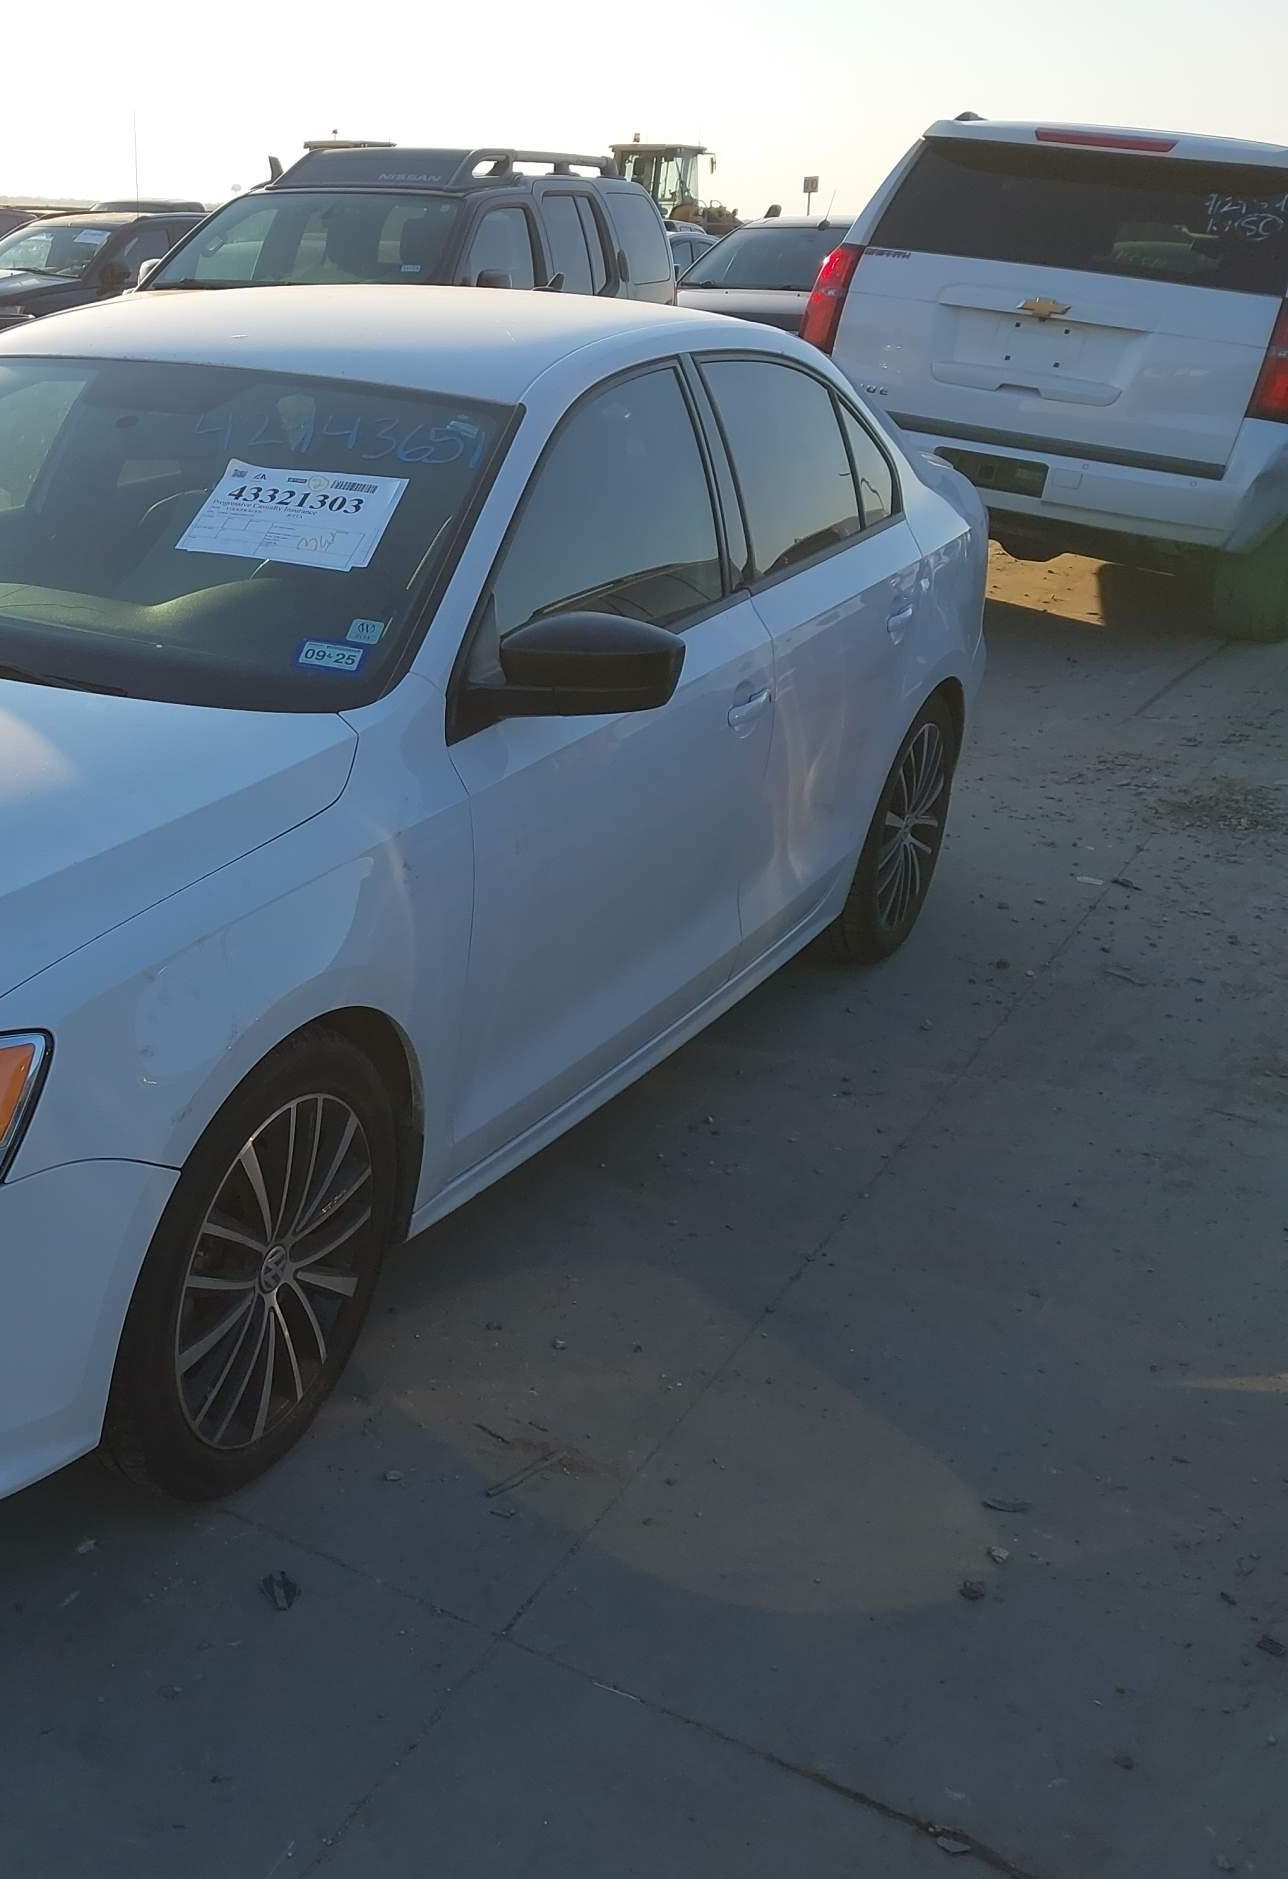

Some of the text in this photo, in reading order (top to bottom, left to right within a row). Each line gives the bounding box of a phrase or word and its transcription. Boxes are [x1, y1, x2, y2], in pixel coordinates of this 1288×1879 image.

[377, 173, 442, 182] NISSAN
[228, 484, 365, 515] 43321303
[304, 648, 328, 661] 09
[333, 652, 357, 666] 25
